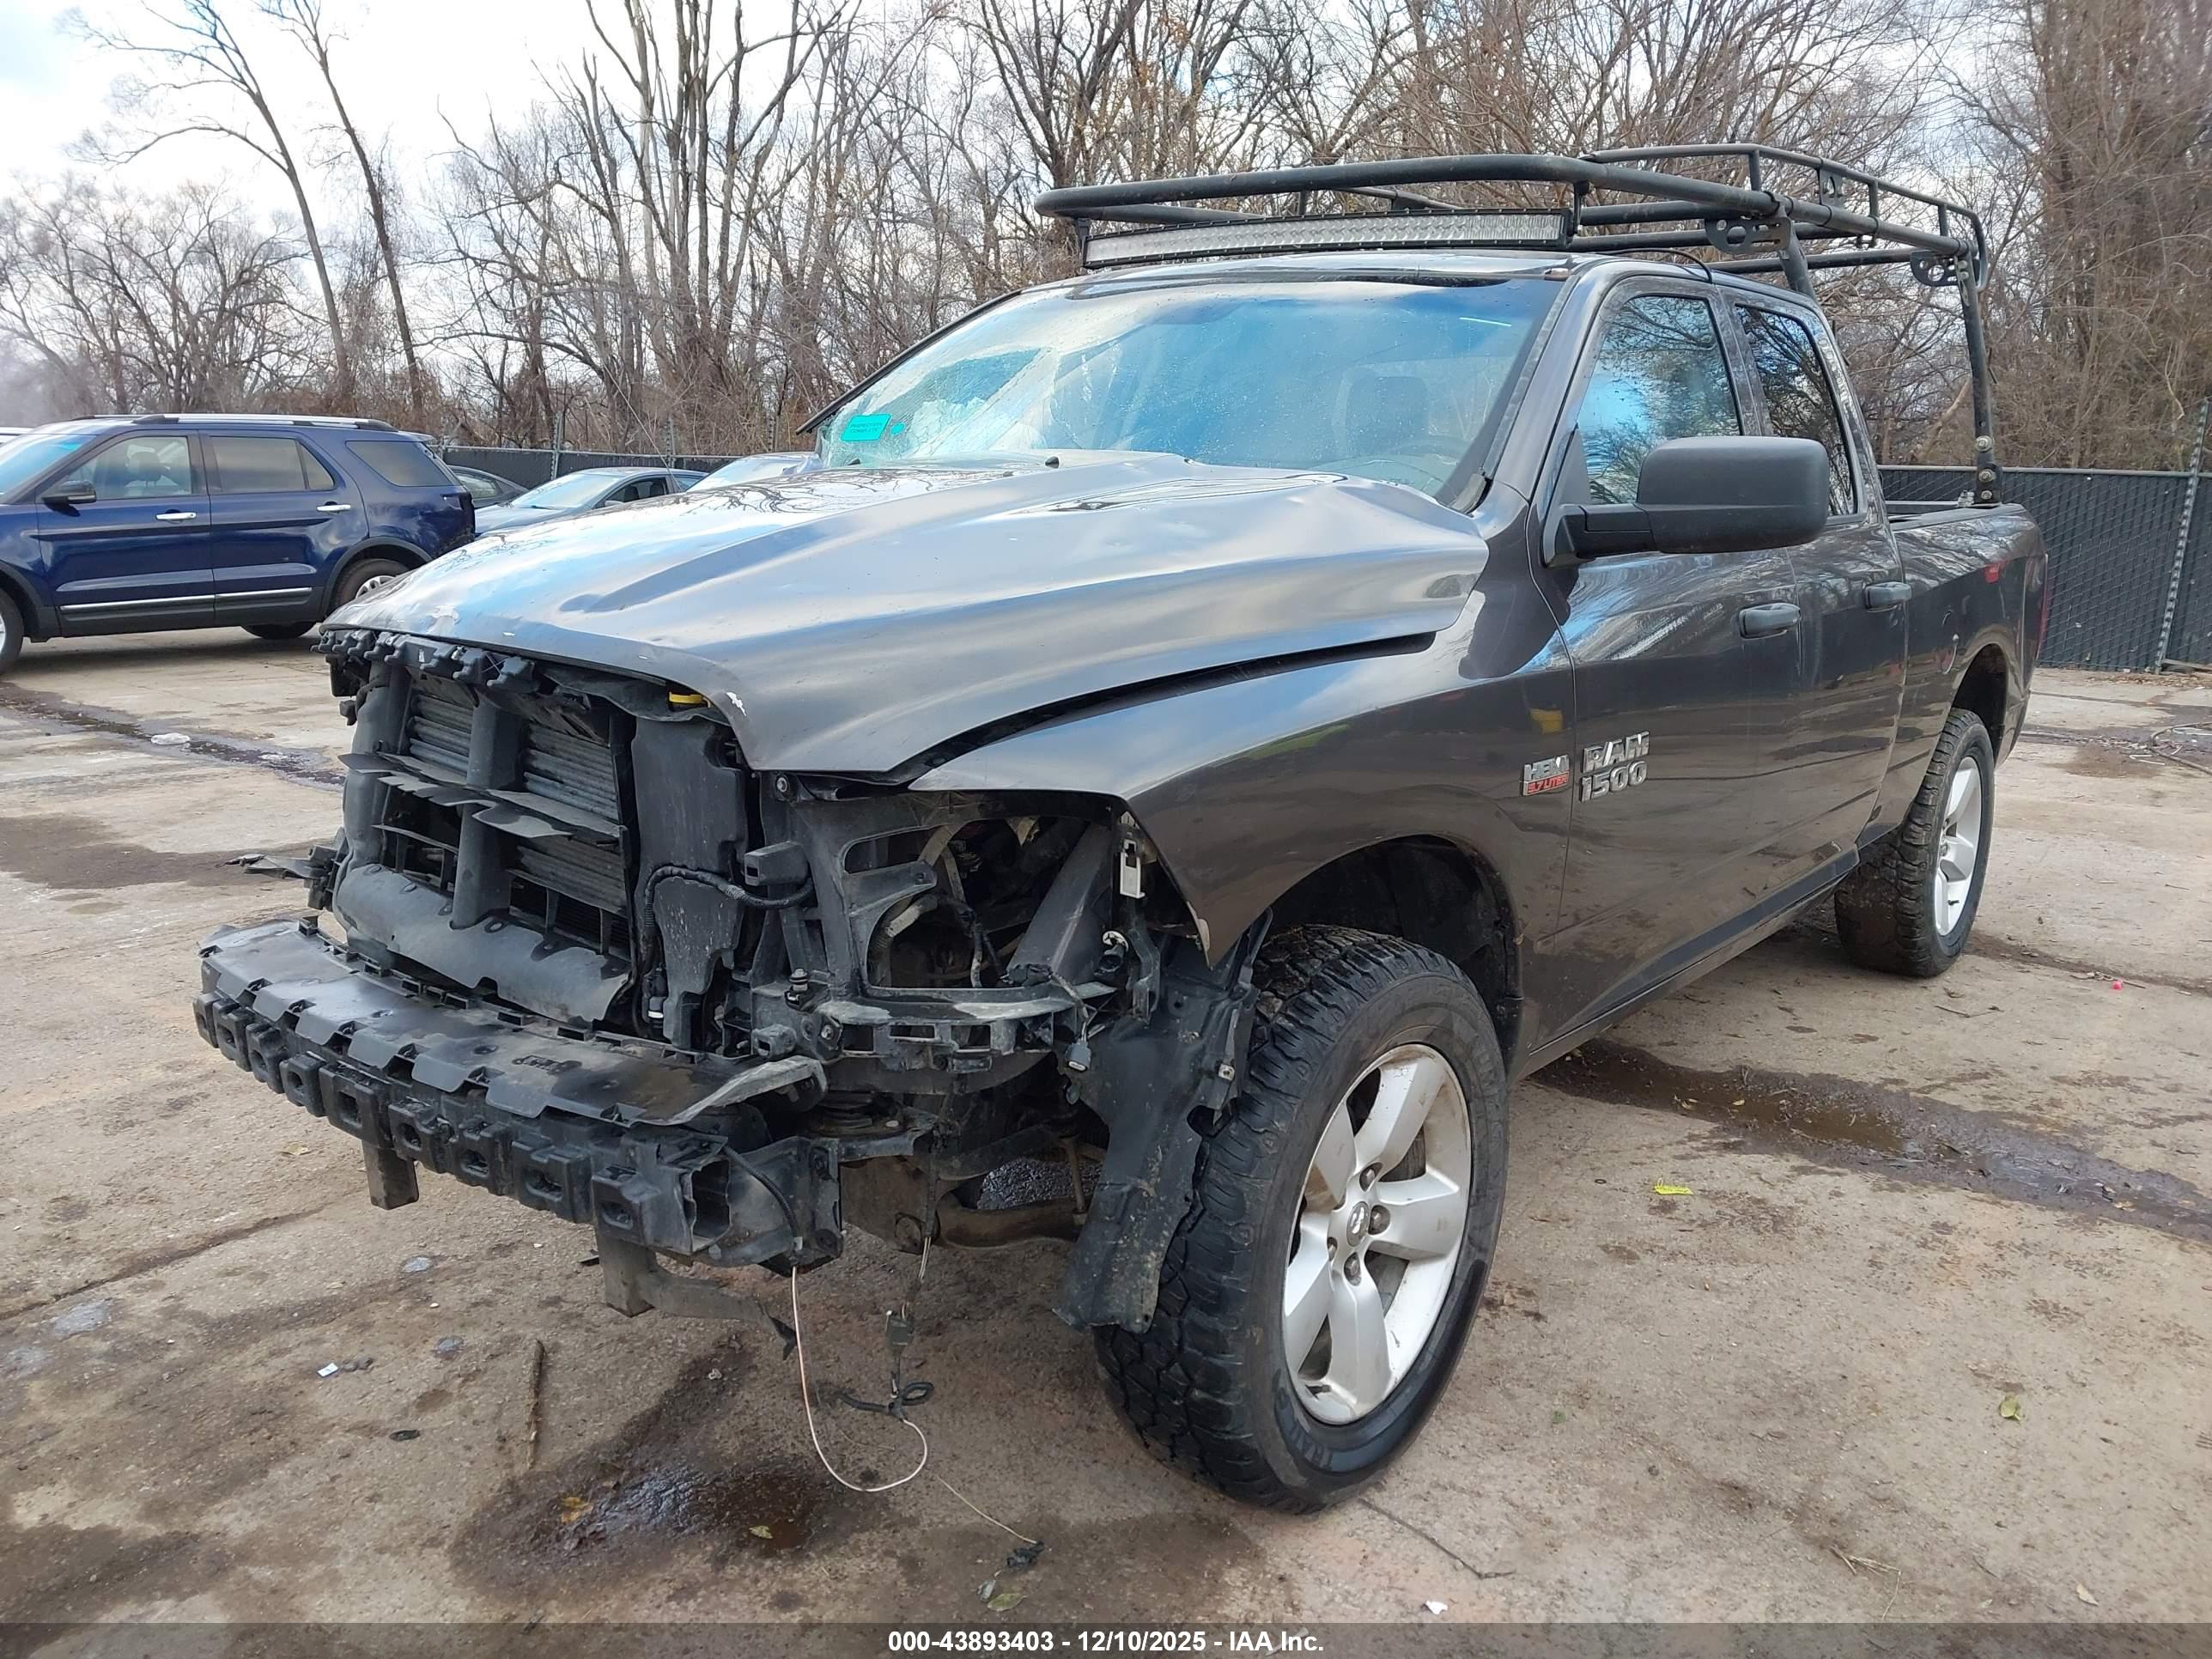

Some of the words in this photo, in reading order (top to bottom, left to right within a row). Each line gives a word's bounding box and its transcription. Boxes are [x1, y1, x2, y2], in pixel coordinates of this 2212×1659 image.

[1523, 754, 1570, 781] HEMI
[1582, 731, 1650, 774] RAM
[1581, 761, 1648, 803] 1500
